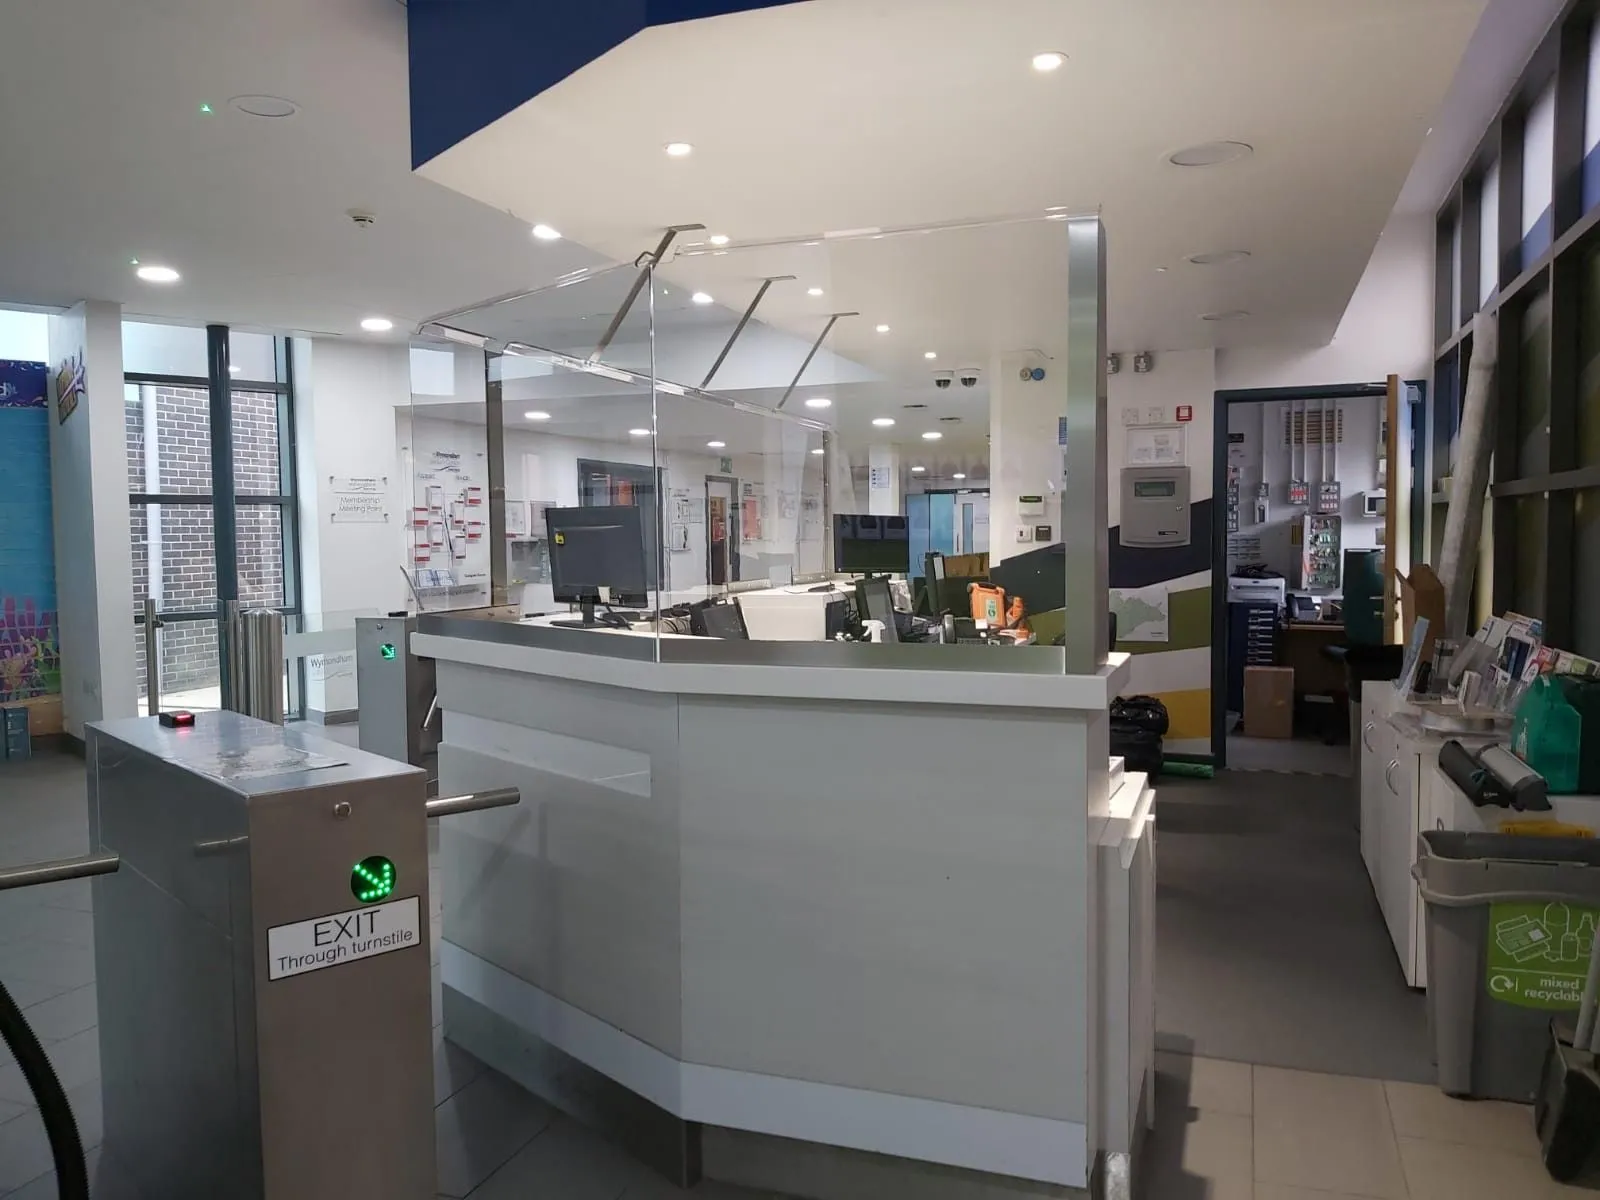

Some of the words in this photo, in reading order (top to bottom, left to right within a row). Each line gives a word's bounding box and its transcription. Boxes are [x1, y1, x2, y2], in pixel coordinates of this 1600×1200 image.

[339, 505, 365, 513] Meeting
[314, 910, 381, 946] EXIT
[278, 944, 347, 971] Through
[352, 929, 413, 953] turnstile
[1540, 977, 1579, 989] mixed
[1525, 988, 1583, 1002] recyclabl
